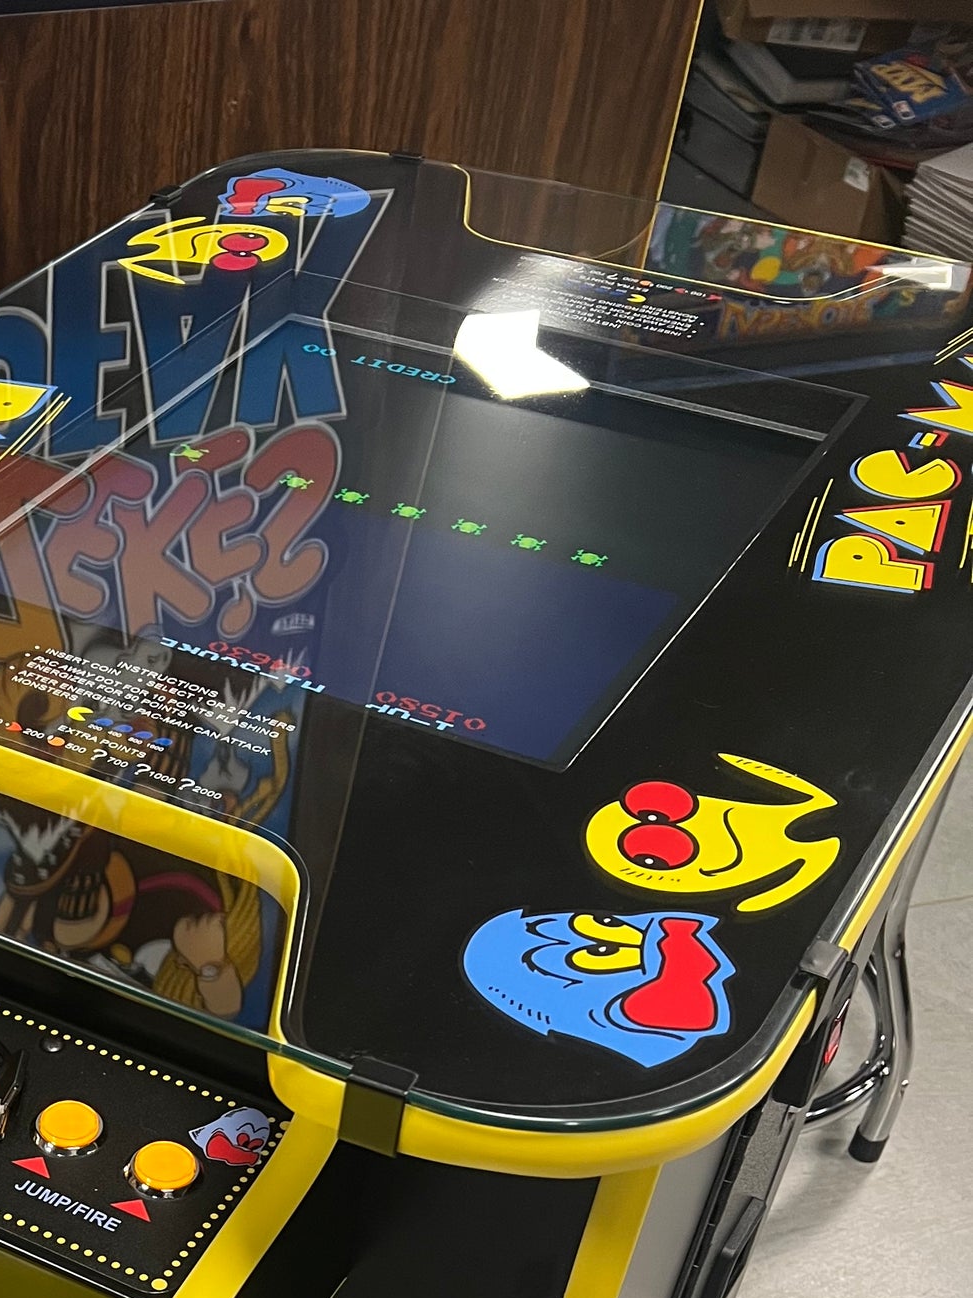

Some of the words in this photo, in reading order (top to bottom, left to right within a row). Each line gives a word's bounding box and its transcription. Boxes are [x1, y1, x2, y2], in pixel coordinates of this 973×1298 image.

[350, 355, 457, 385] CREDIT
[11, 675, 79, 702] MONSTERS
[26, 661, 96, 689] ENERGIZER
[95, 684, 124, 698] FOR
[123, 692, 140, 702] 50
[140, 698, 188, 718] POINTS
[33, 655, 59, 668] PAC
[57, 664, 96, 679] AWAY
[95, 674, 123, 690] DOT
[122, 684, 149, 698] FOR
[153, 693, 167, 702] 10
[167, 698, 215, 718] POINTS
[215, 713, 280, 739] FLASHING
[45, 648, 91, 666] INSERT
[90, 662, 122, 677] COIN
[145, 680, 197, 700] SELECT
[204, 699, 226, 711] OR
[226, 706, 237, 714] 2
[237, 709, 296, 732] PLAYERS
[117, 660, 219, 698] INSTRUCTIONS
[17, 669, 59, 686] AFTER
[59, 682, 134, 712] ENERGIZING
[134, 707, 194, 730] PAC-MAN
[193, 726, 221, 740] CAN
[220, 736, 273, 757] ATTACK
[22, 728, 45, 740] 200
[64, 742, 87, 754] 500
[107, 756, 129, 768] 700
[149, 771, 177, 785] 1000
[192, 786, 223, 800] 2000
[57, 724, 98, 744] EXTRA
[99, 738, 147, 759] POINTS
[14, 1178, 123, 1233] JUMP/FIRE
